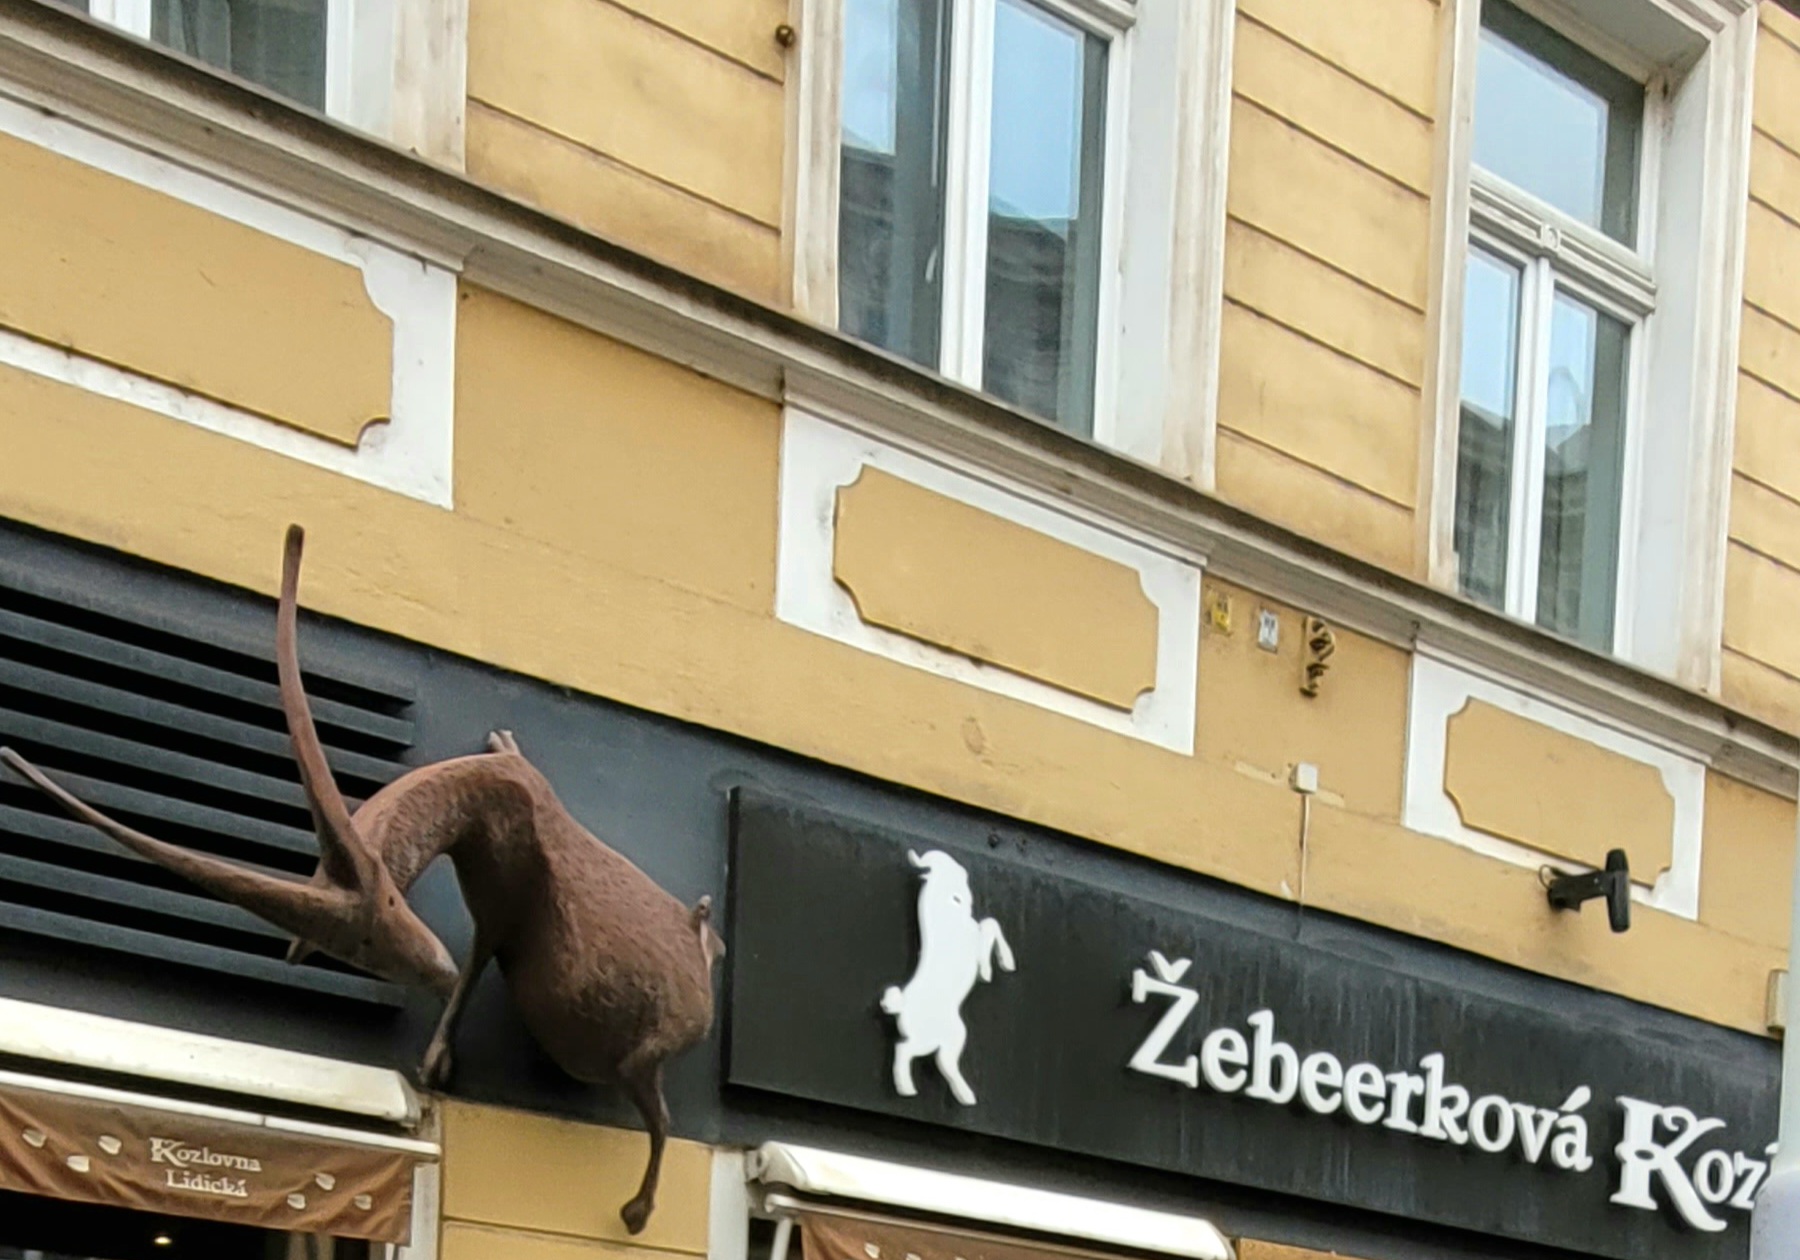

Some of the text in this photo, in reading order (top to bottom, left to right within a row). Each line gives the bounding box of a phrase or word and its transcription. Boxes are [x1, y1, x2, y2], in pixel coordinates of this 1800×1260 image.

[1127, 950, 1778, 1232] Žebeerková Koz
[149, 1136, 262, 1172] Kozlovna
[165, 1168, 248, 1197] Lidická
